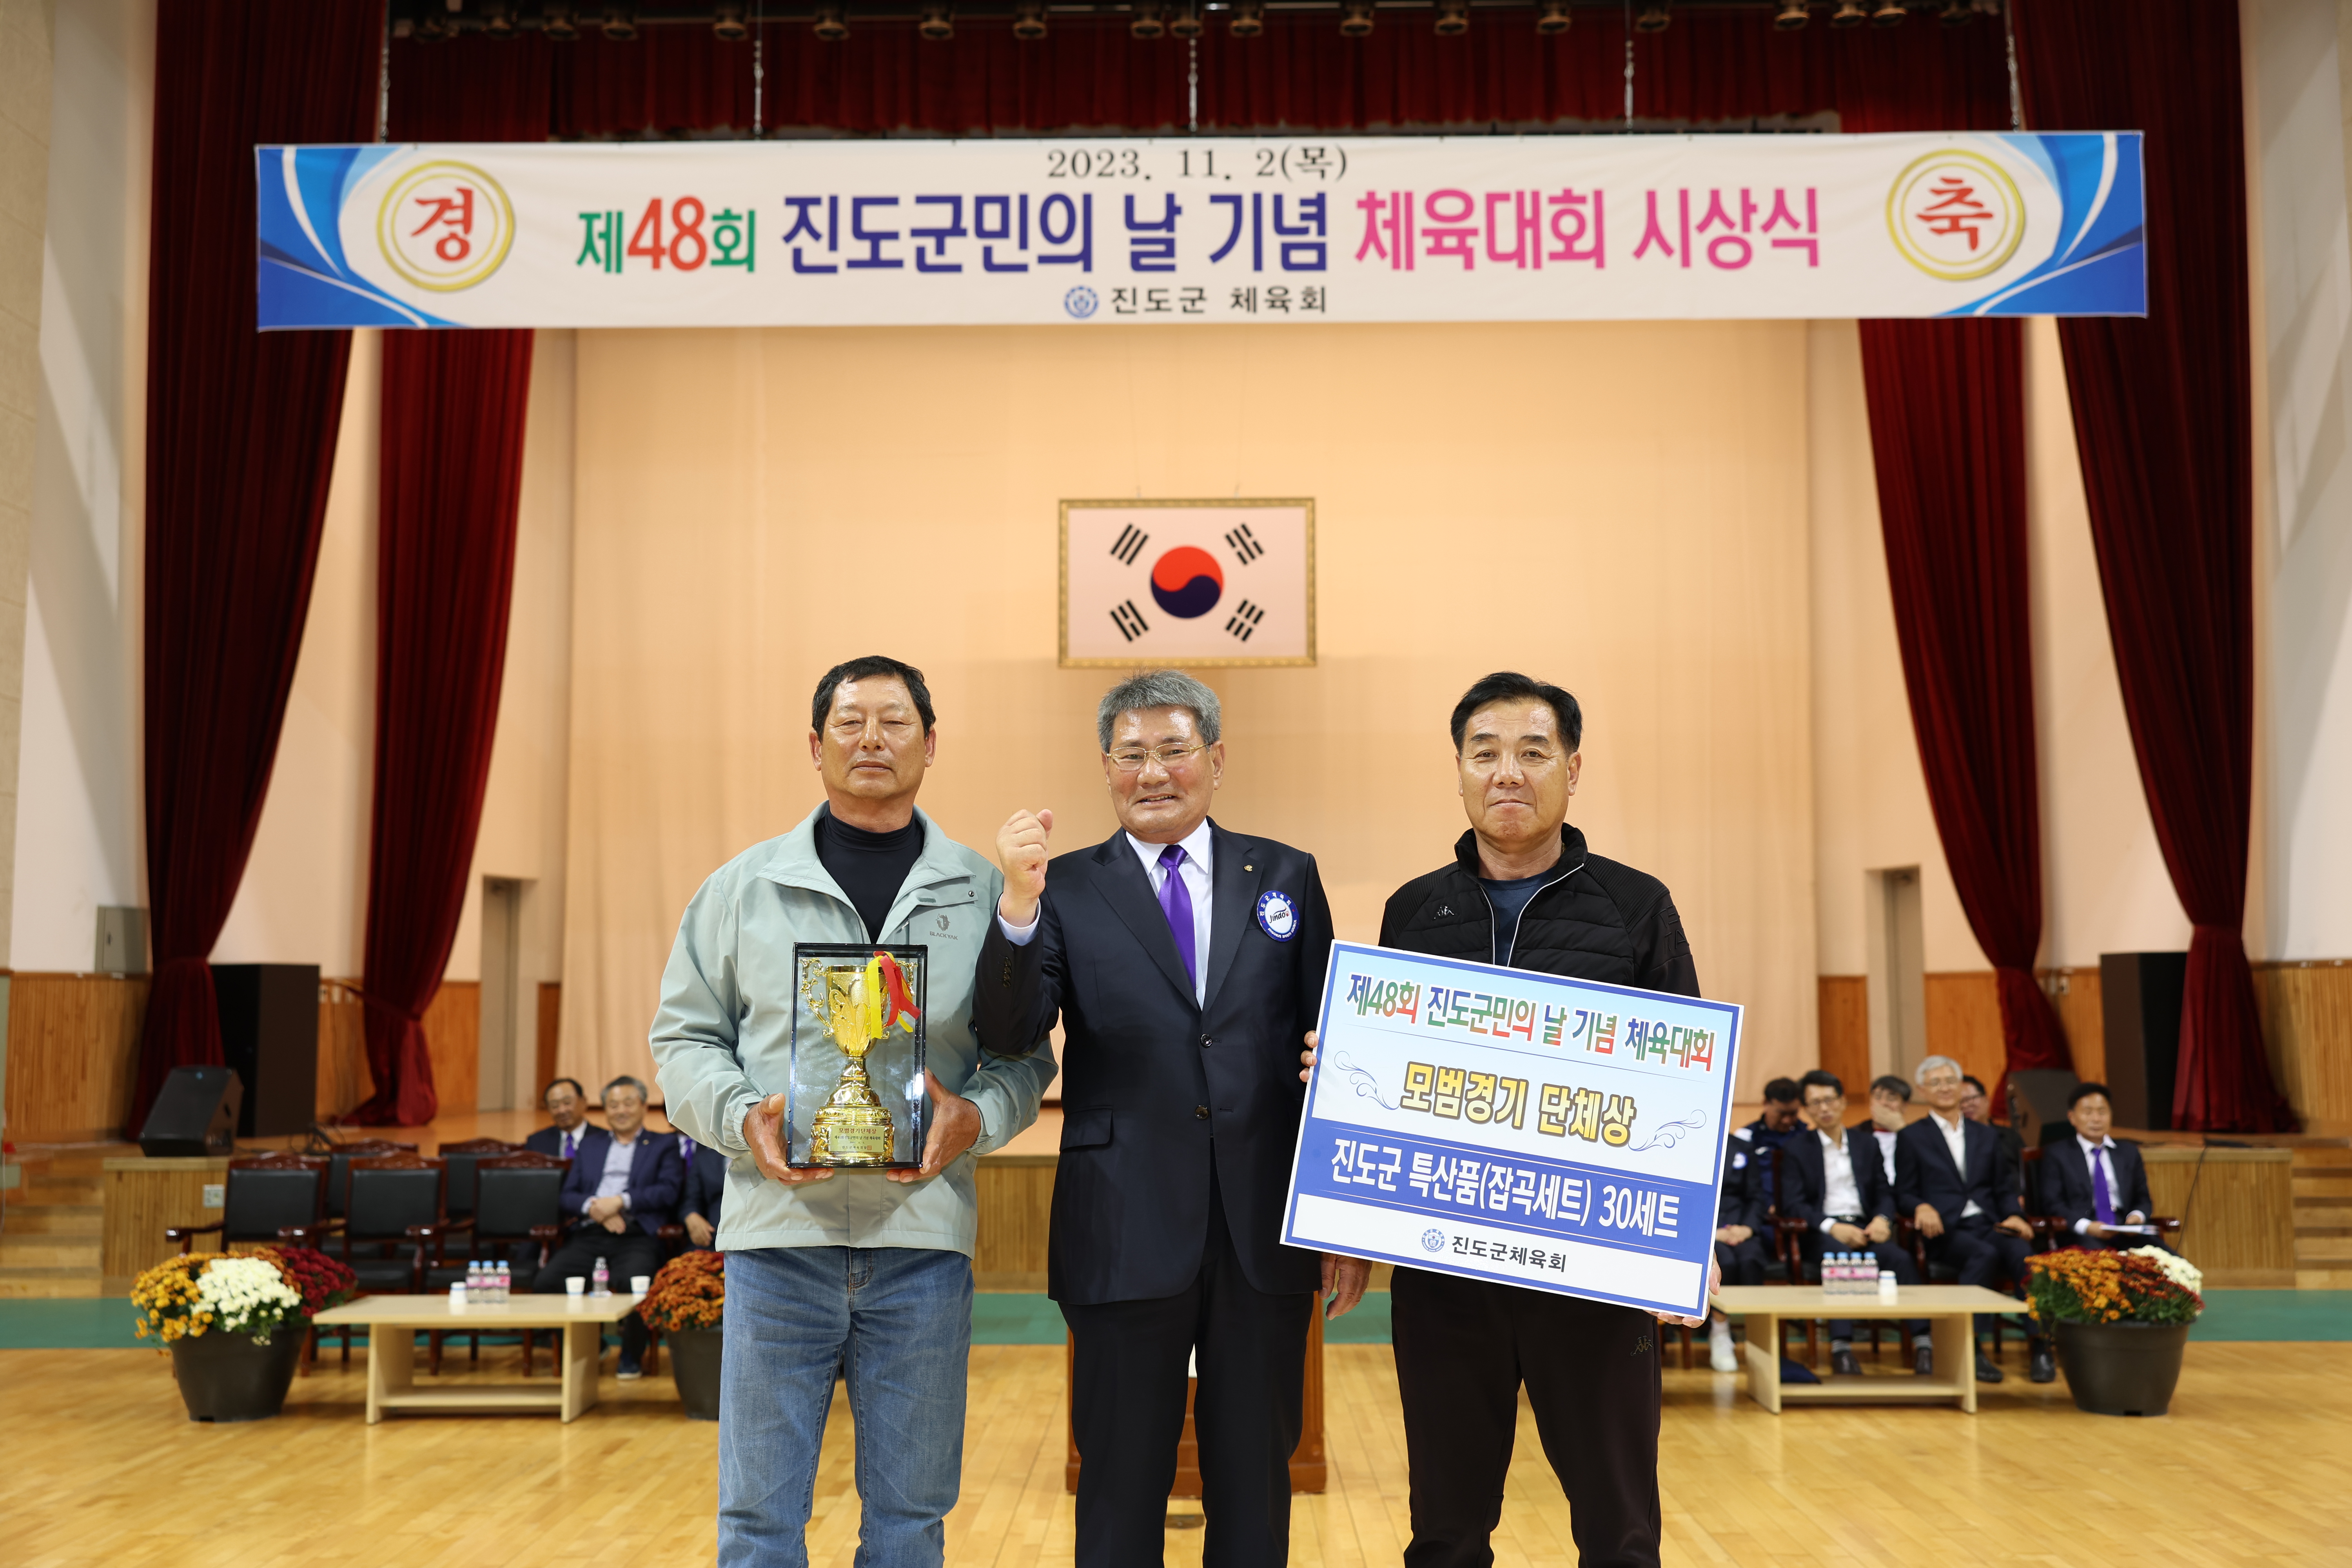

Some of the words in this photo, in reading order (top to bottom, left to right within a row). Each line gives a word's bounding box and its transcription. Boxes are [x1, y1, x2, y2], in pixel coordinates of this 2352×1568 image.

[1047, 148, 1153, 181] 2023.
[1178, 149, 1232, 181] 11.
[1256, 144, 1348, 183] 2(목)
[410, 187, 474, 263] 경
[576, 196, 756, 274] 제48회
[782, 192, 1093, 274] 진도군민의
[1124, 192, 1182, 273] 날
[1209, 191, 1327, 272] 기념
[1355, 188, 1606, 272] 체육대회
[1632, 187, 1820, 271] 시상식
[1915, 176, 1994, 251] 축
[1111, 287, 1207, 314] 진도군
[1230, 285, 1327, 314] 체육회
[1270, 912, 1285, 923] Jindo
[1347, 974, 1421, 1024] 제48회
[1428, 986, 1536, 1042] 진도군민의
[1543, 1005, 1567, 1046] 날
[1572, 1010, 1617, 1054] 기념
[1625, 1018, 1715, 1072] 체육대회
[1400, 1061, 1529, 1130] 모범경기
[1537, 1083, 1637, 1147] 단체상
[1331, 1138, 1402, 1192] 진도군
[1409, 1152, 1591, 1227] 특산품(잡곡세트)
[1599, 1185, 1680, 1238] 30세트
[1452, 1236, 1566, 1272] 진도군체육회
